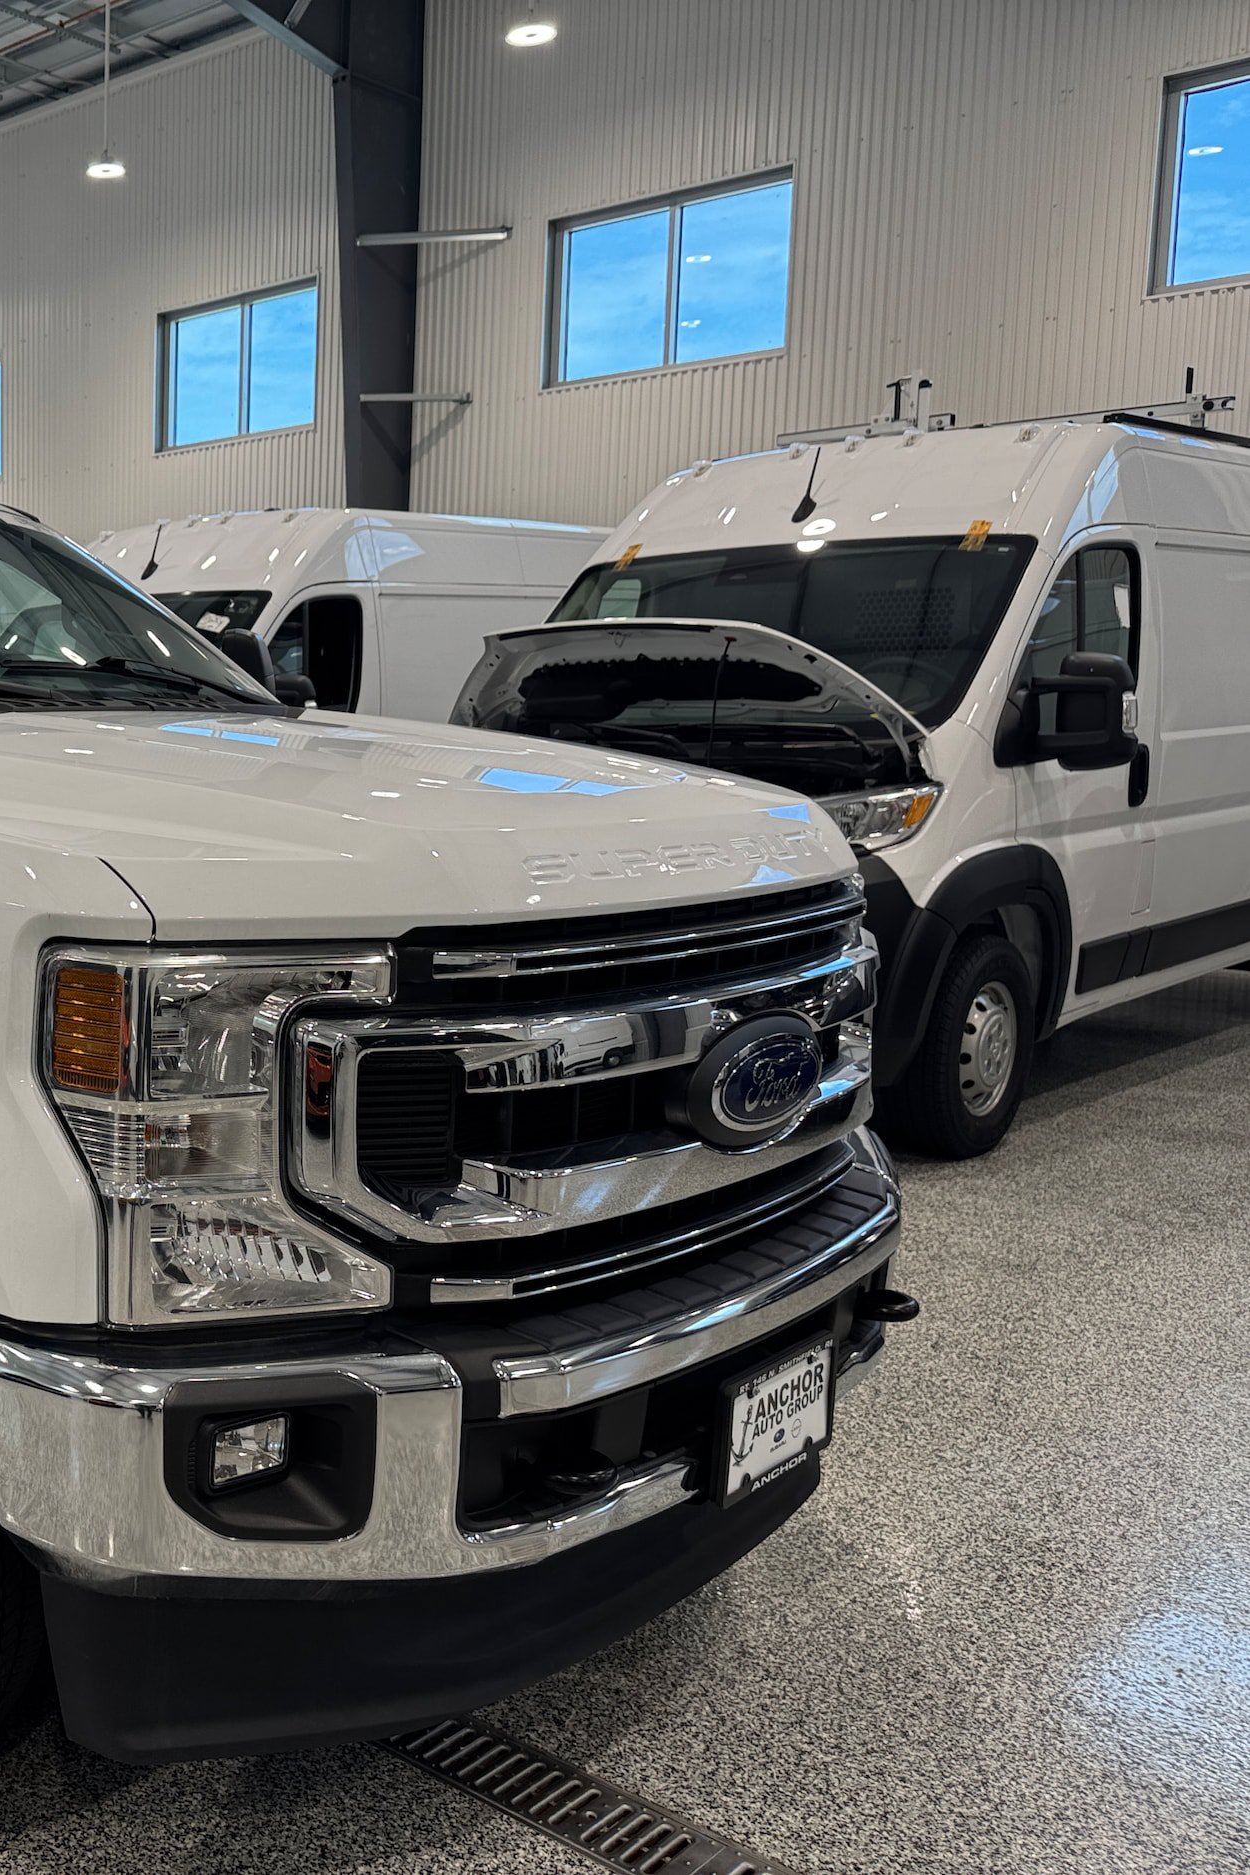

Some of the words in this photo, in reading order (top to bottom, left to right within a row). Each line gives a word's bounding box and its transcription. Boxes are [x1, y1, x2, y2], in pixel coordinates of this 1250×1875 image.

[521, 841, 735, 885] SUPER
[729, 827, 830, 864] DUTY
[744, 1050, 810, 1113] Ford
[753, 1373, 767, 1386] 146
[824, 1339, 834, 1349] RI
[751, 1409, 784, 1441] AUTO
[786, 1384, 823, 1418] GROUP
[754, 1362, 825, 1424] ANCHOR
[751, 1451, 808, 1492] ANCHOR
